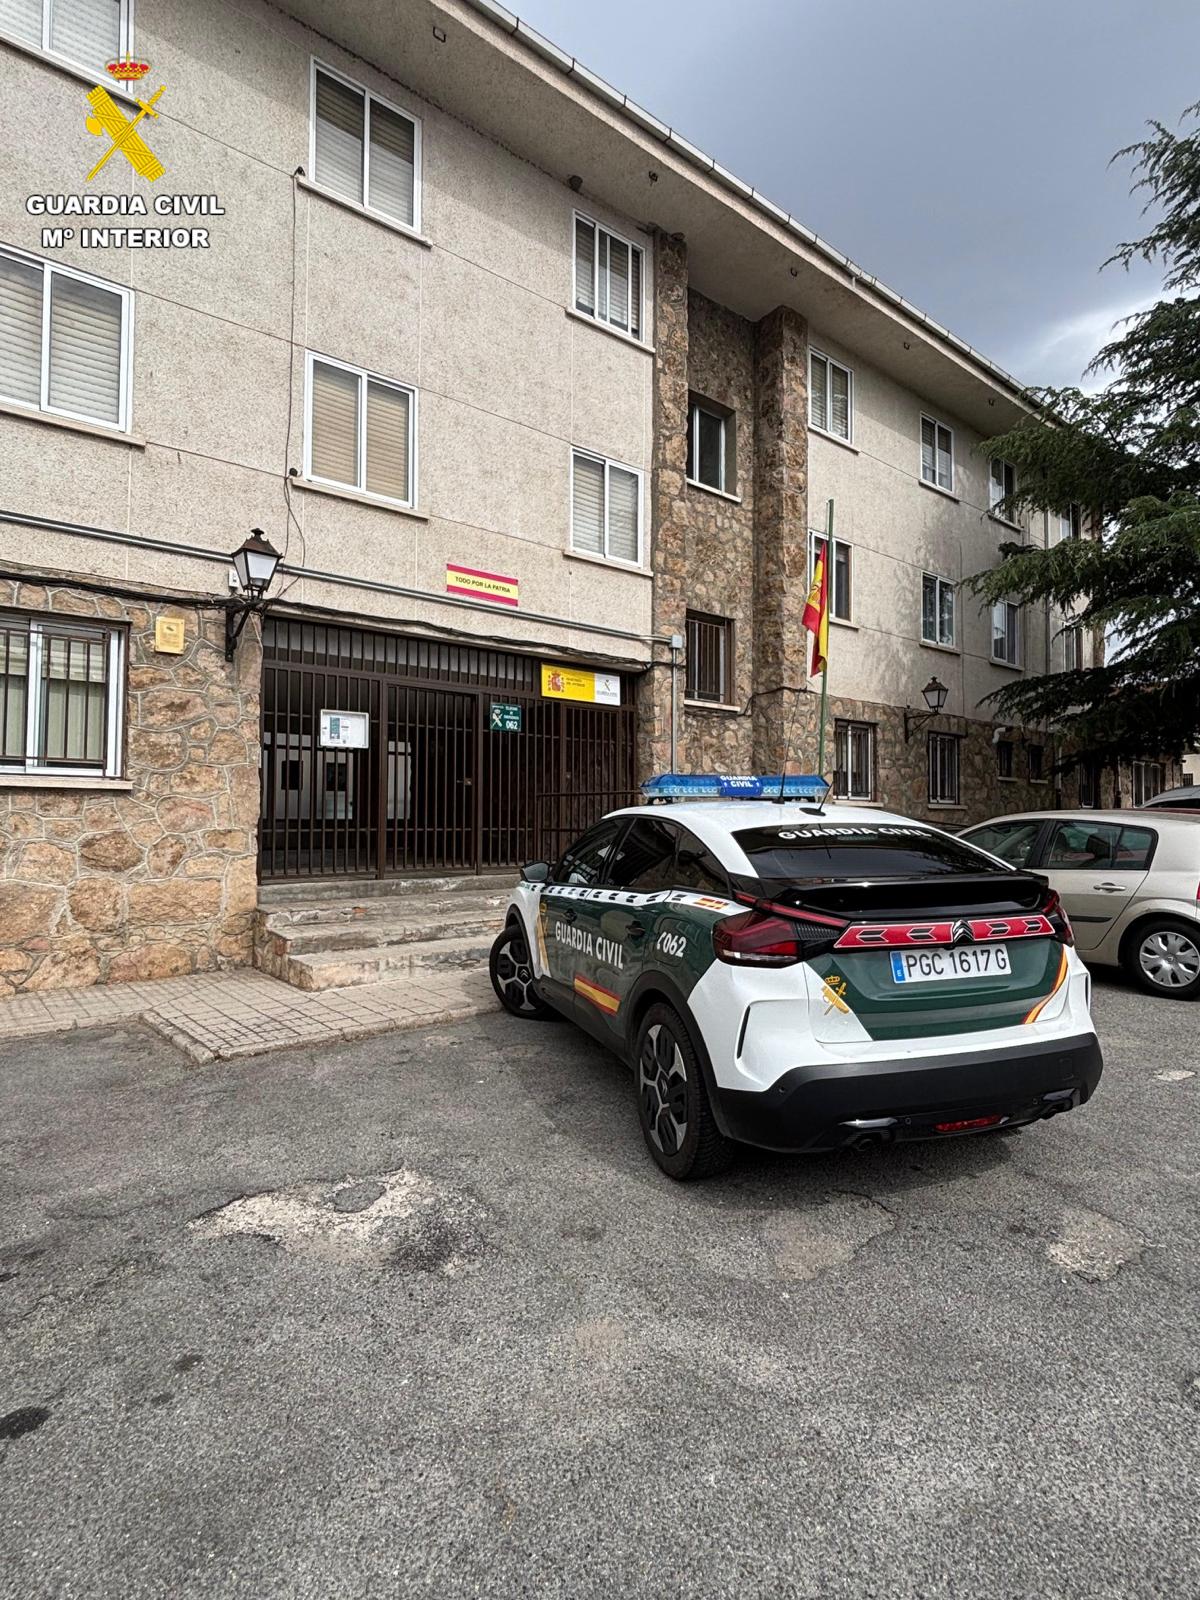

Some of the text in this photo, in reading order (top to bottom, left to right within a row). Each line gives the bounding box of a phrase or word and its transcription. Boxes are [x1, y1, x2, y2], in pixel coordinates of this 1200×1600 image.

[455, 576, 471, 585] TODO
[492, 585, 511, 593] PATRIA
[505, 720, 518, 730] 062
[778, 827, 932, 840] GUARDIA CIVIL
[555, 921, 624, 969] GUARDIA CIVIL
[662, 932, 687, 958] 062
[905, 953, 944, 977] PGC
[949, 949, 991, 974] 1617
[995, 948, 1007, 970] G
